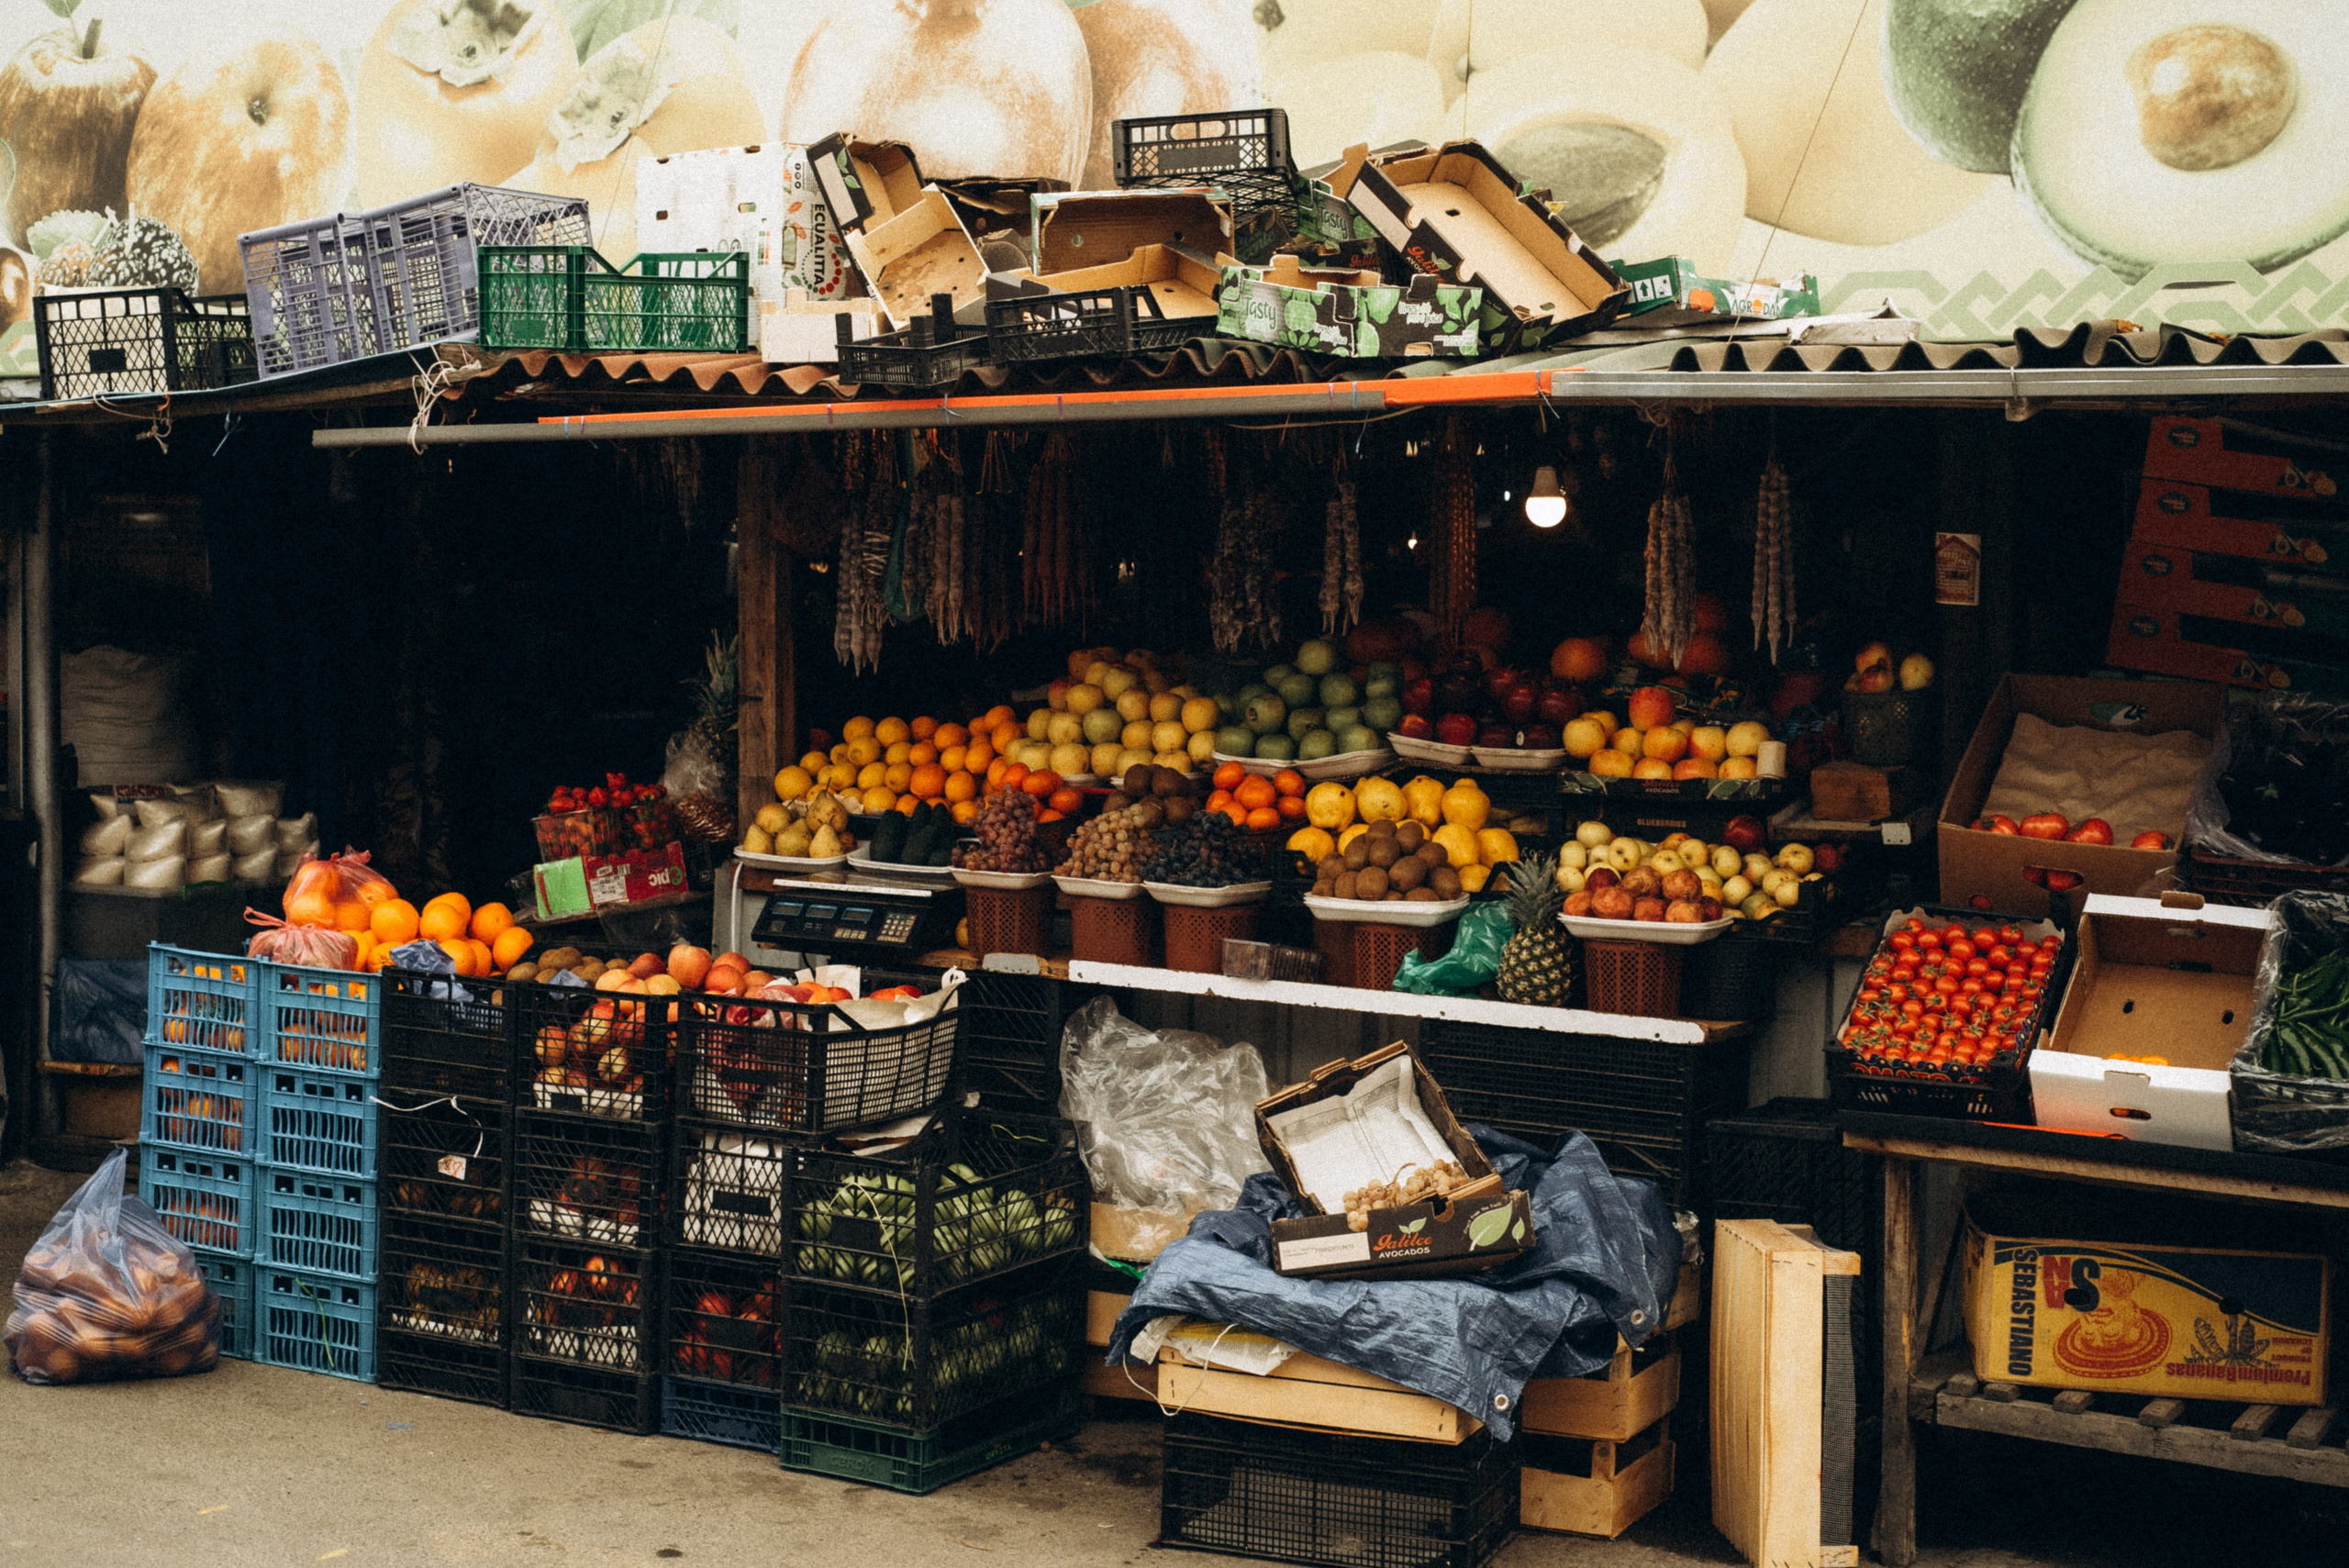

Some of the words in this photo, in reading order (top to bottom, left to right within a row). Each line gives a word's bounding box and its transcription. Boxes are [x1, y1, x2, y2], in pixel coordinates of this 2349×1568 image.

[1319, 206, 1348, 239] Tasty
[814, 204, 825, 284] ECUALITTA
[1243, 295, 1277, 330] Tasty
[1637, 818, 1687, 828] BLUEBERRIES
[1379, 1247, 1431, 1259] AVOCADOS
[2008, 1249, 2038, 1376] SEBASTIANO
